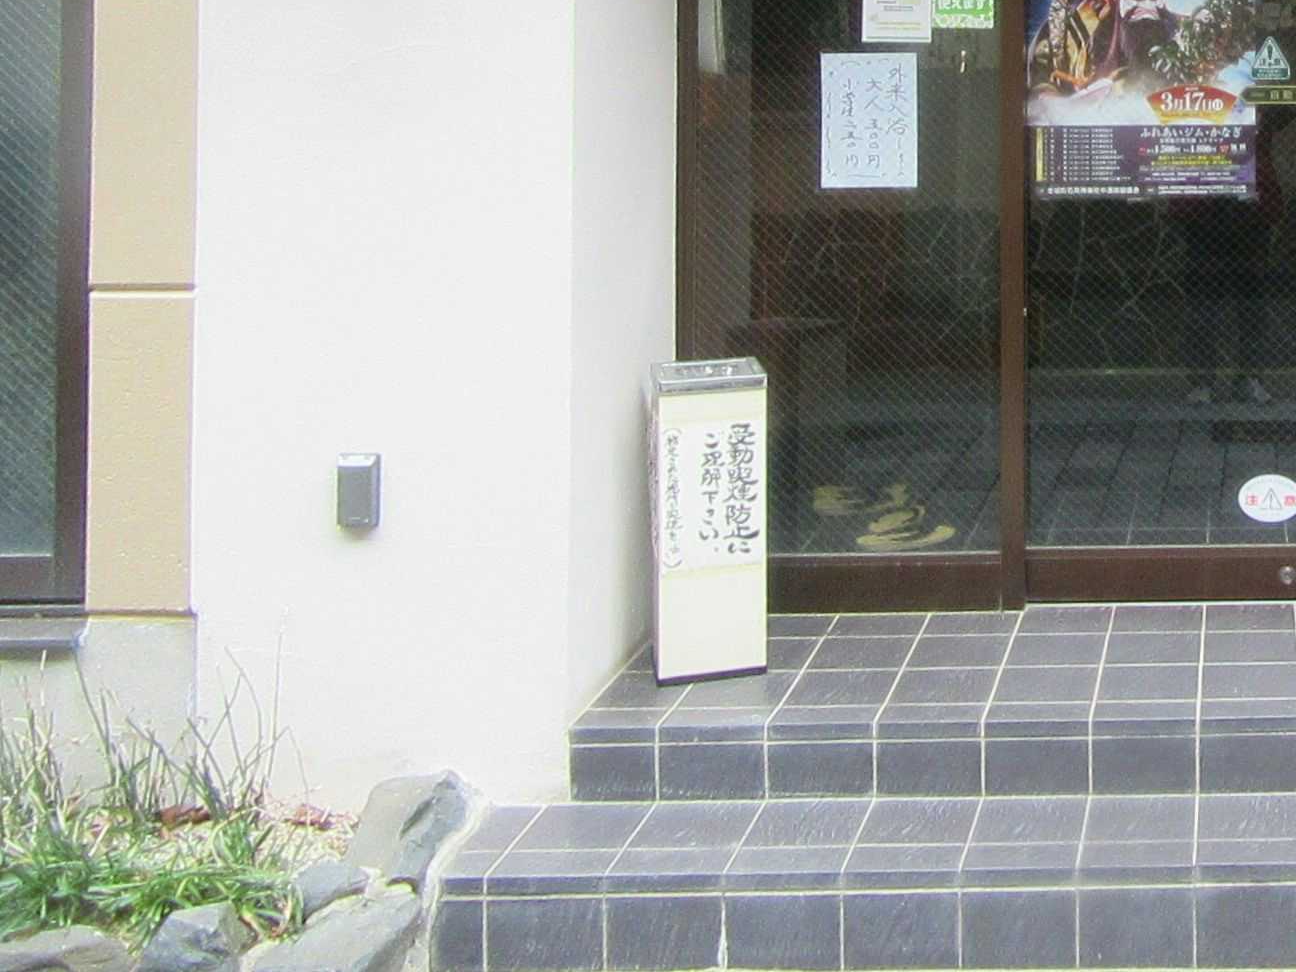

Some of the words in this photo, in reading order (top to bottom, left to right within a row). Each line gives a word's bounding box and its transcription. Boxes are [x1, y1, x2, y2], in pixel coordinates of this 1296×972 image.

[723, 423, 760, 554] 受動喫煙防止に
